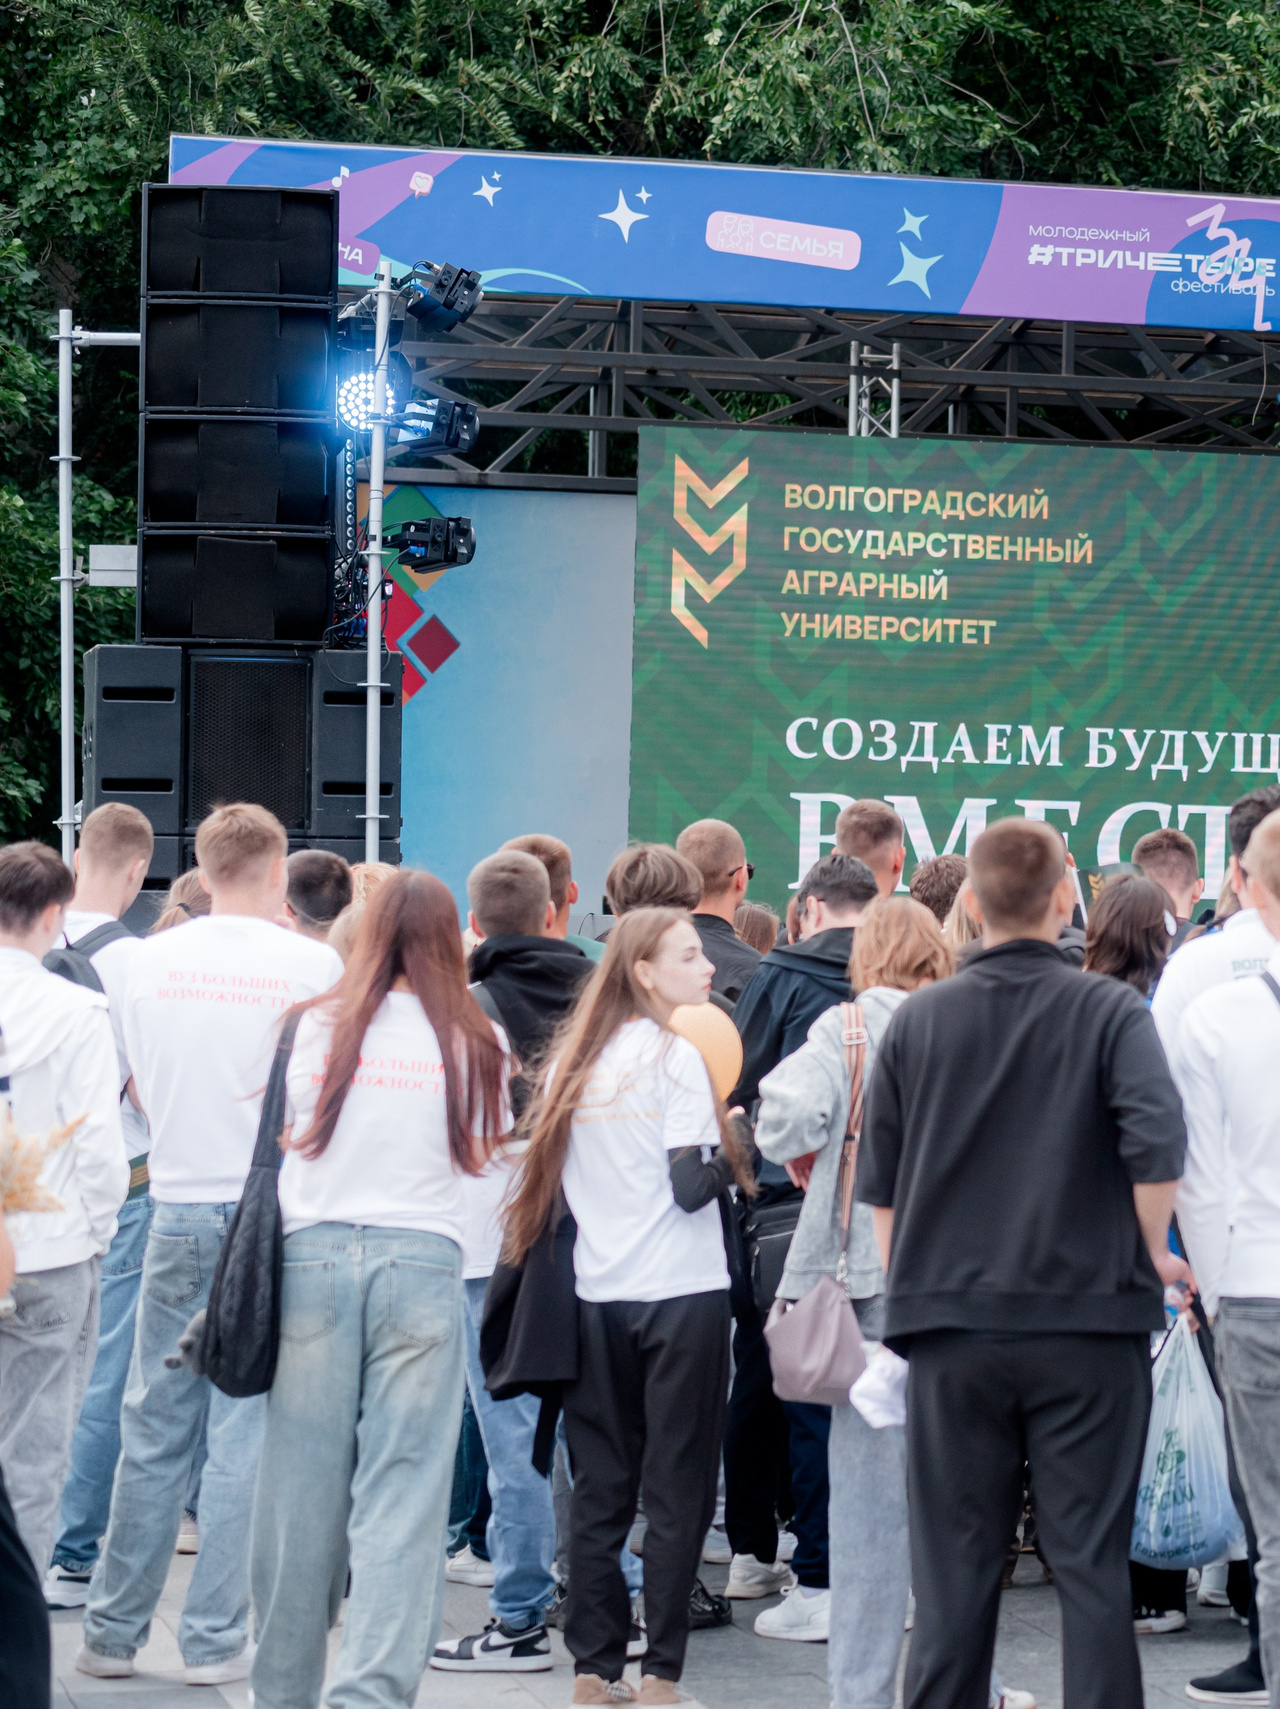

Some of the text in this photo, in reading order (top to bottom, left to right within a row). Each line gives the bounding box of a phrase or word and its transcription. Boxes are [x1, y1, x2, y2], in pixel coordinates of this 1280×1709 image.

[758, 230, 845, 260] СЕМЬЯ
[1028, 224, 1151, 243] молодежный
[1027, 243, 1277, 279] #ТРИЧЕТЫРЕ
[784, 483, 1049, 521] ВОЛГОГРАДСКИЙ
[783, 526, 1094, 565] ГОСУДАРСТВЕННЫЙ
[780, 568, 949, 602] АГРАРНЫЙ
[780, 611, 997, 646] УНИВЕРСИТЕТ
[785, 716, 1064, 775] СОЗДАЕМ
[167, 970, 291, 993] ВУЗ БОЛЬШИХ
